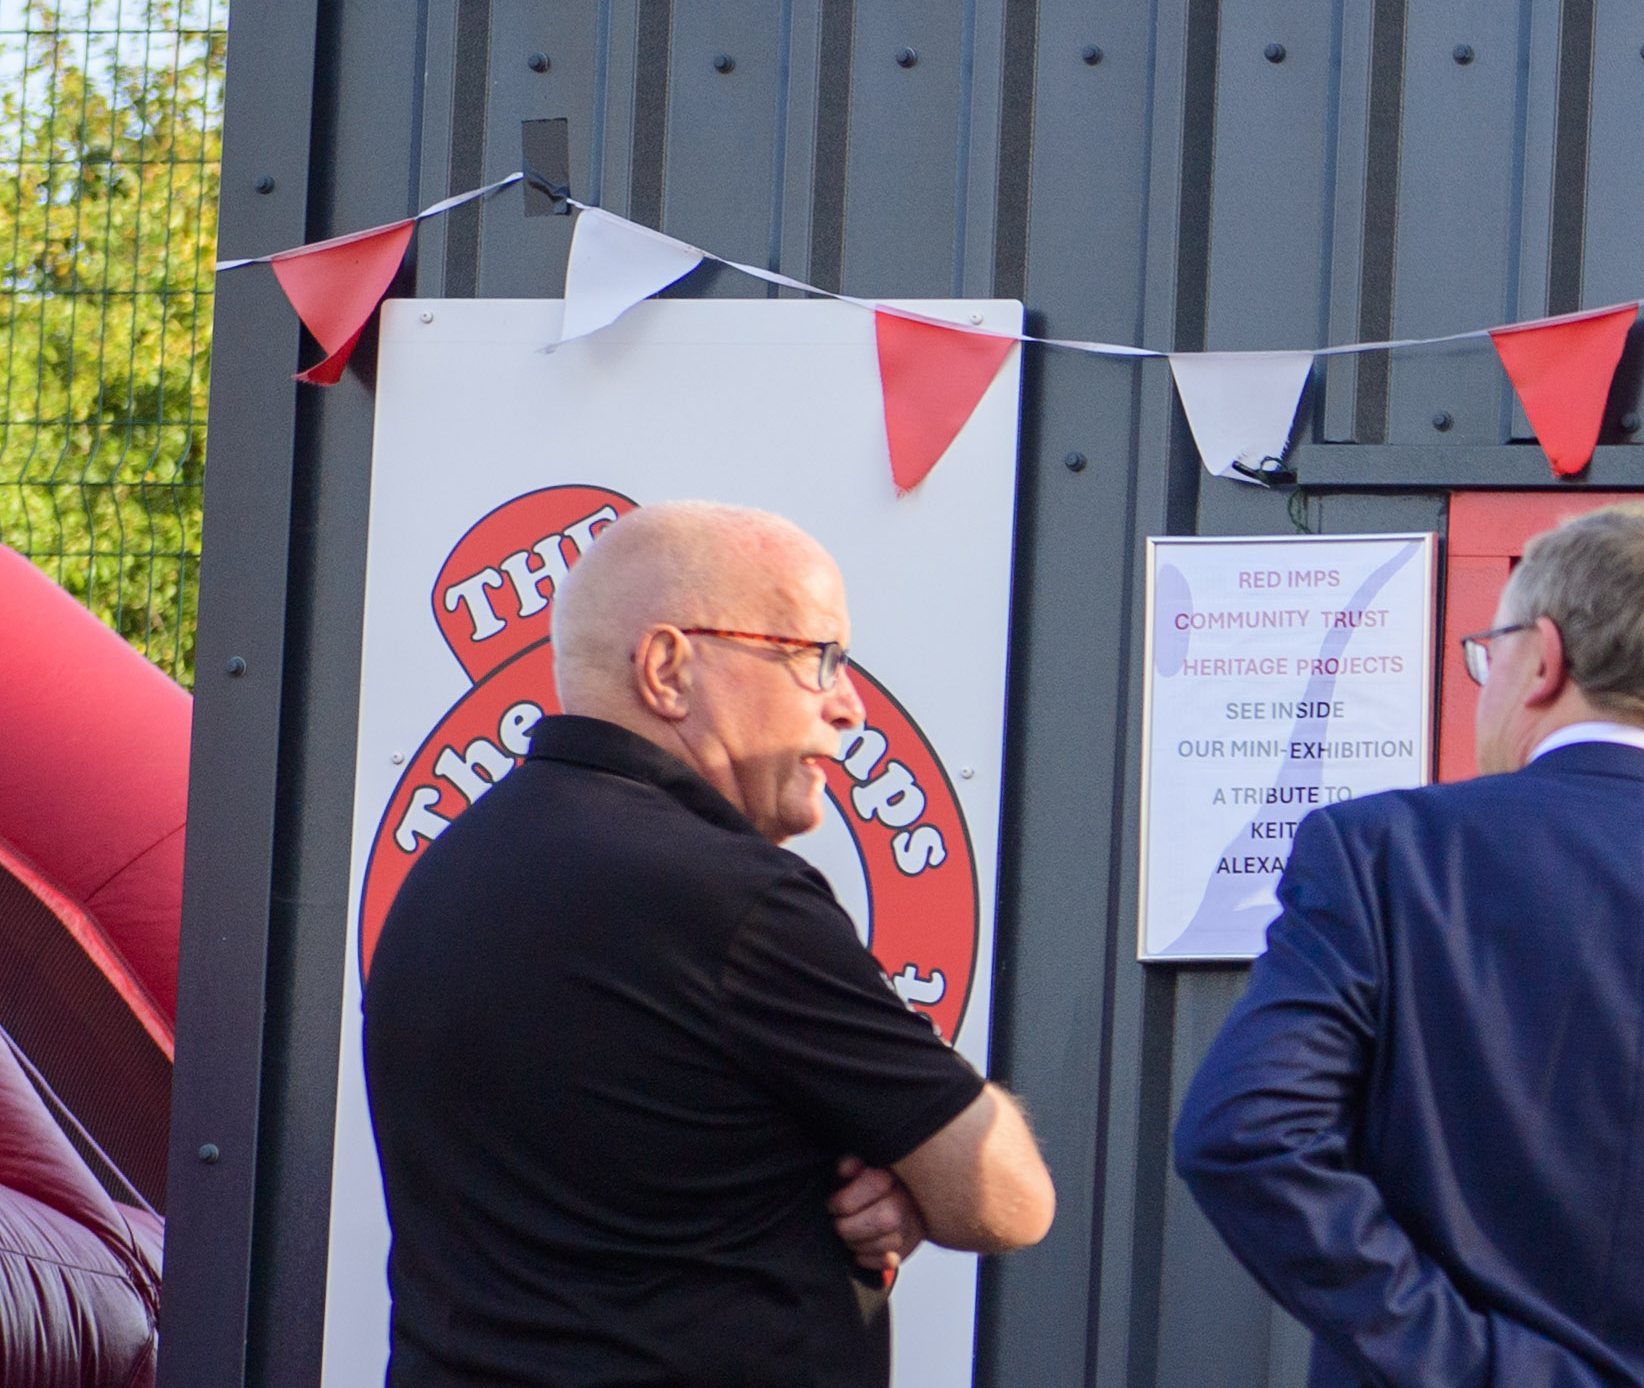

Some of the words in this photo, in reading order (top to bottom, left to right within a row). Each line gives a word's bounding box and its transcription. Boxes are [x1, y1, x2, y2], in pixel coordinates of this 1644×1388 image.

[1238, 571, 1281, 589] RED
[1288, 570, 1341, 588] IMPS
[1174, 611, 1309, 631] COMMUNITY
[1321, 610, 1389, 629] TRUST
[1183, 657, 1287, 676] HERITAGE
[1296, 656, 1404, 676] PROJECTS
[1226, 702, 1266, 721] SEE
[1272, 701, 1345, 720] INSIDE
[1177, 740, 1227, 758] OUR
[1231, 739, 1414, 760] MINI-EXHIBITION
[393, 700, 545, 854] The
[828, 726, 948, 878] mps
[1212, 788, 1226, 805] A
[1232, 786, 1319, 805] TRIBUTE
[1325, 785, 1353, 803] TO
[1251, 821, 1298, 839] KEIT
[1216, 856, 1290, 875] ALEXA
